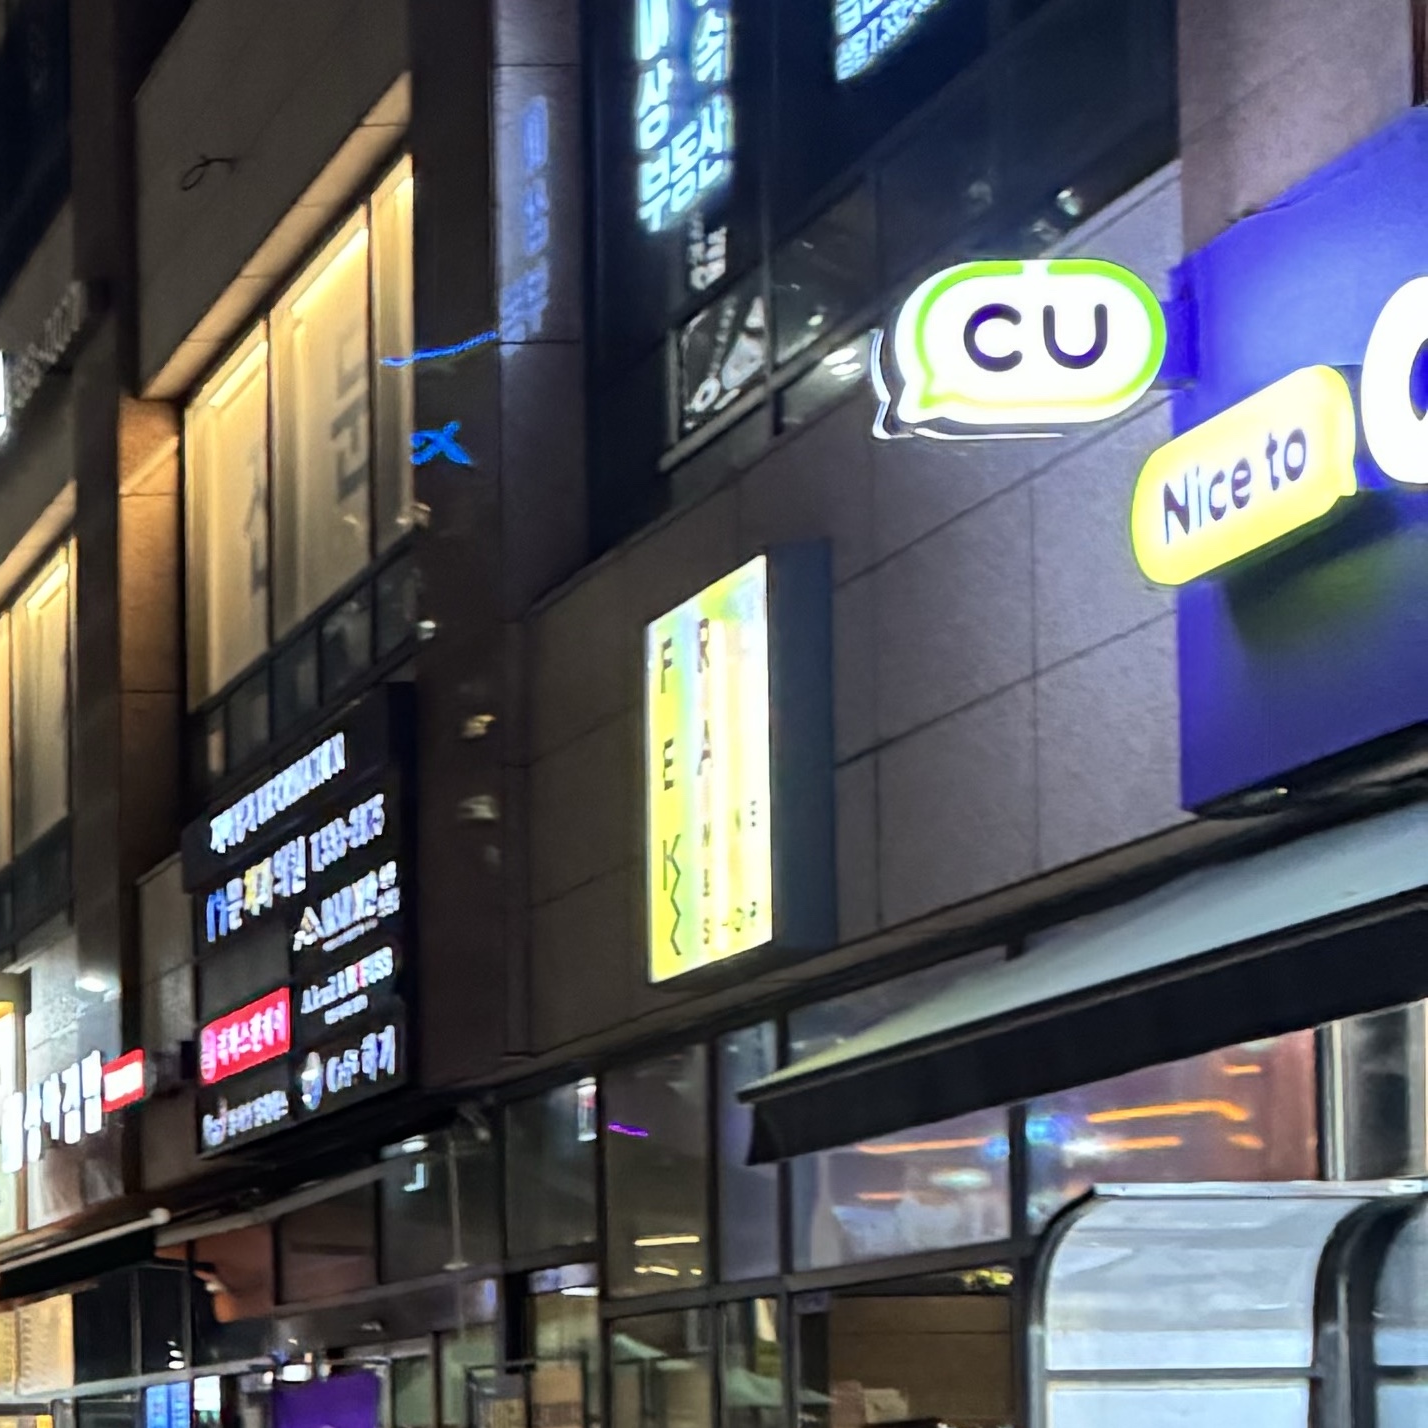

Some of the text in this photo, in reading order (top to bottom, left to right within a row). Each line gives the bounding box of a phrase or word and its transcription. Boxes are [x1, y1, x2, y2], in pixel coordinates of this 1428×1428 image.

[963, 303, 1108, 372] CU
[1162, 427, 1308, 545] Nice to
